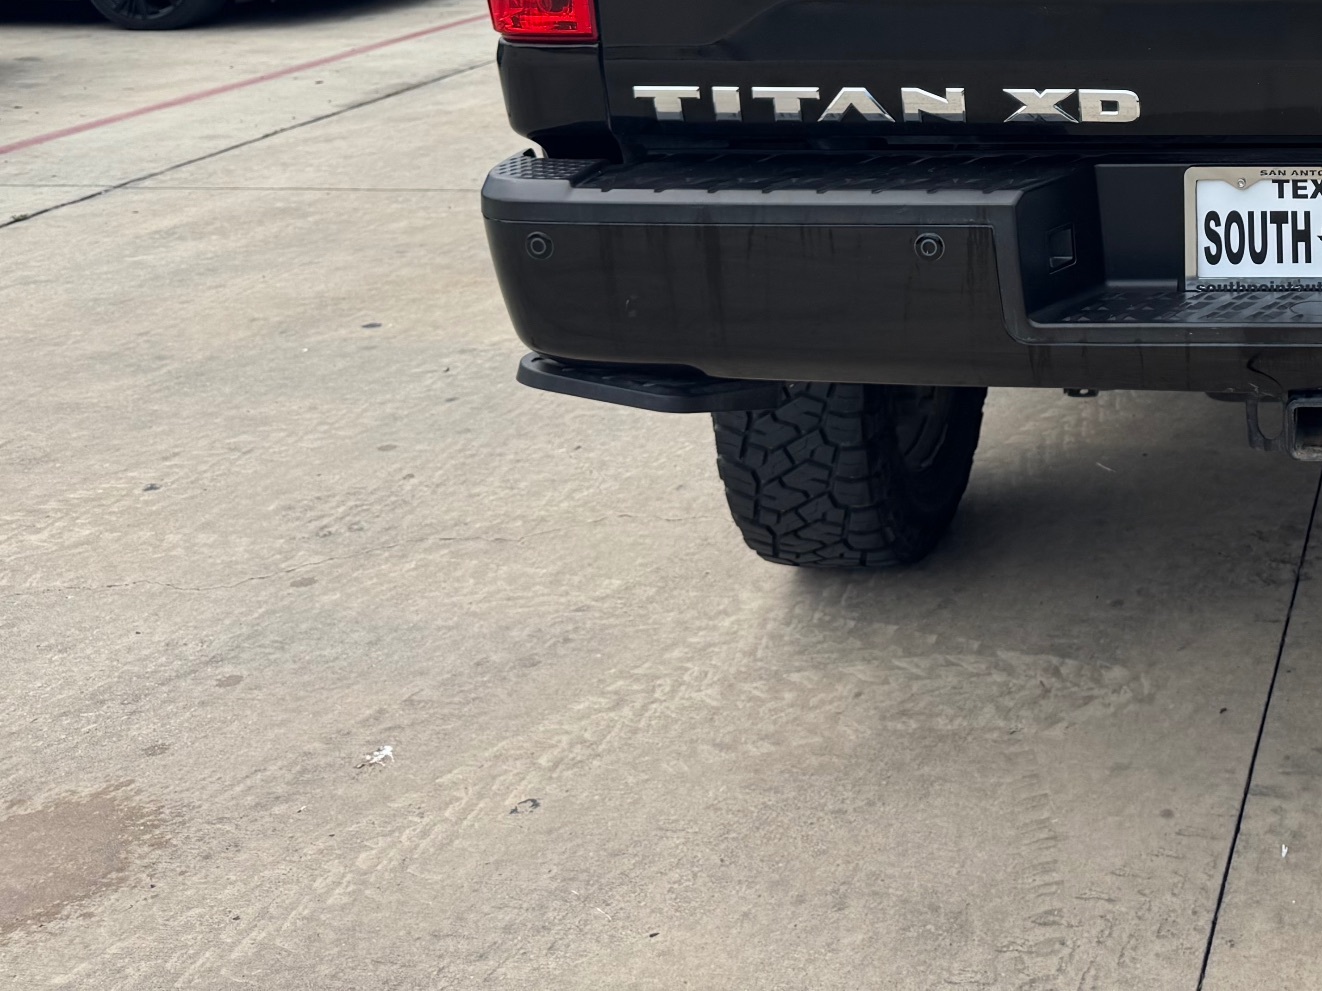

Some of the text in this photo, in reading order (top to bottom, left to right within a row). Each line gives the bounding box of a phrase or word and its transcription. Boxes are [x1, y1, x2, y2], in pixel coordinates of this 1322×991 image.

[633, 86, 1141, 123] TITAN XD
[1260, 169, 1286, 177] SAN
[1204, 209, 1312, 266] SOUTH
